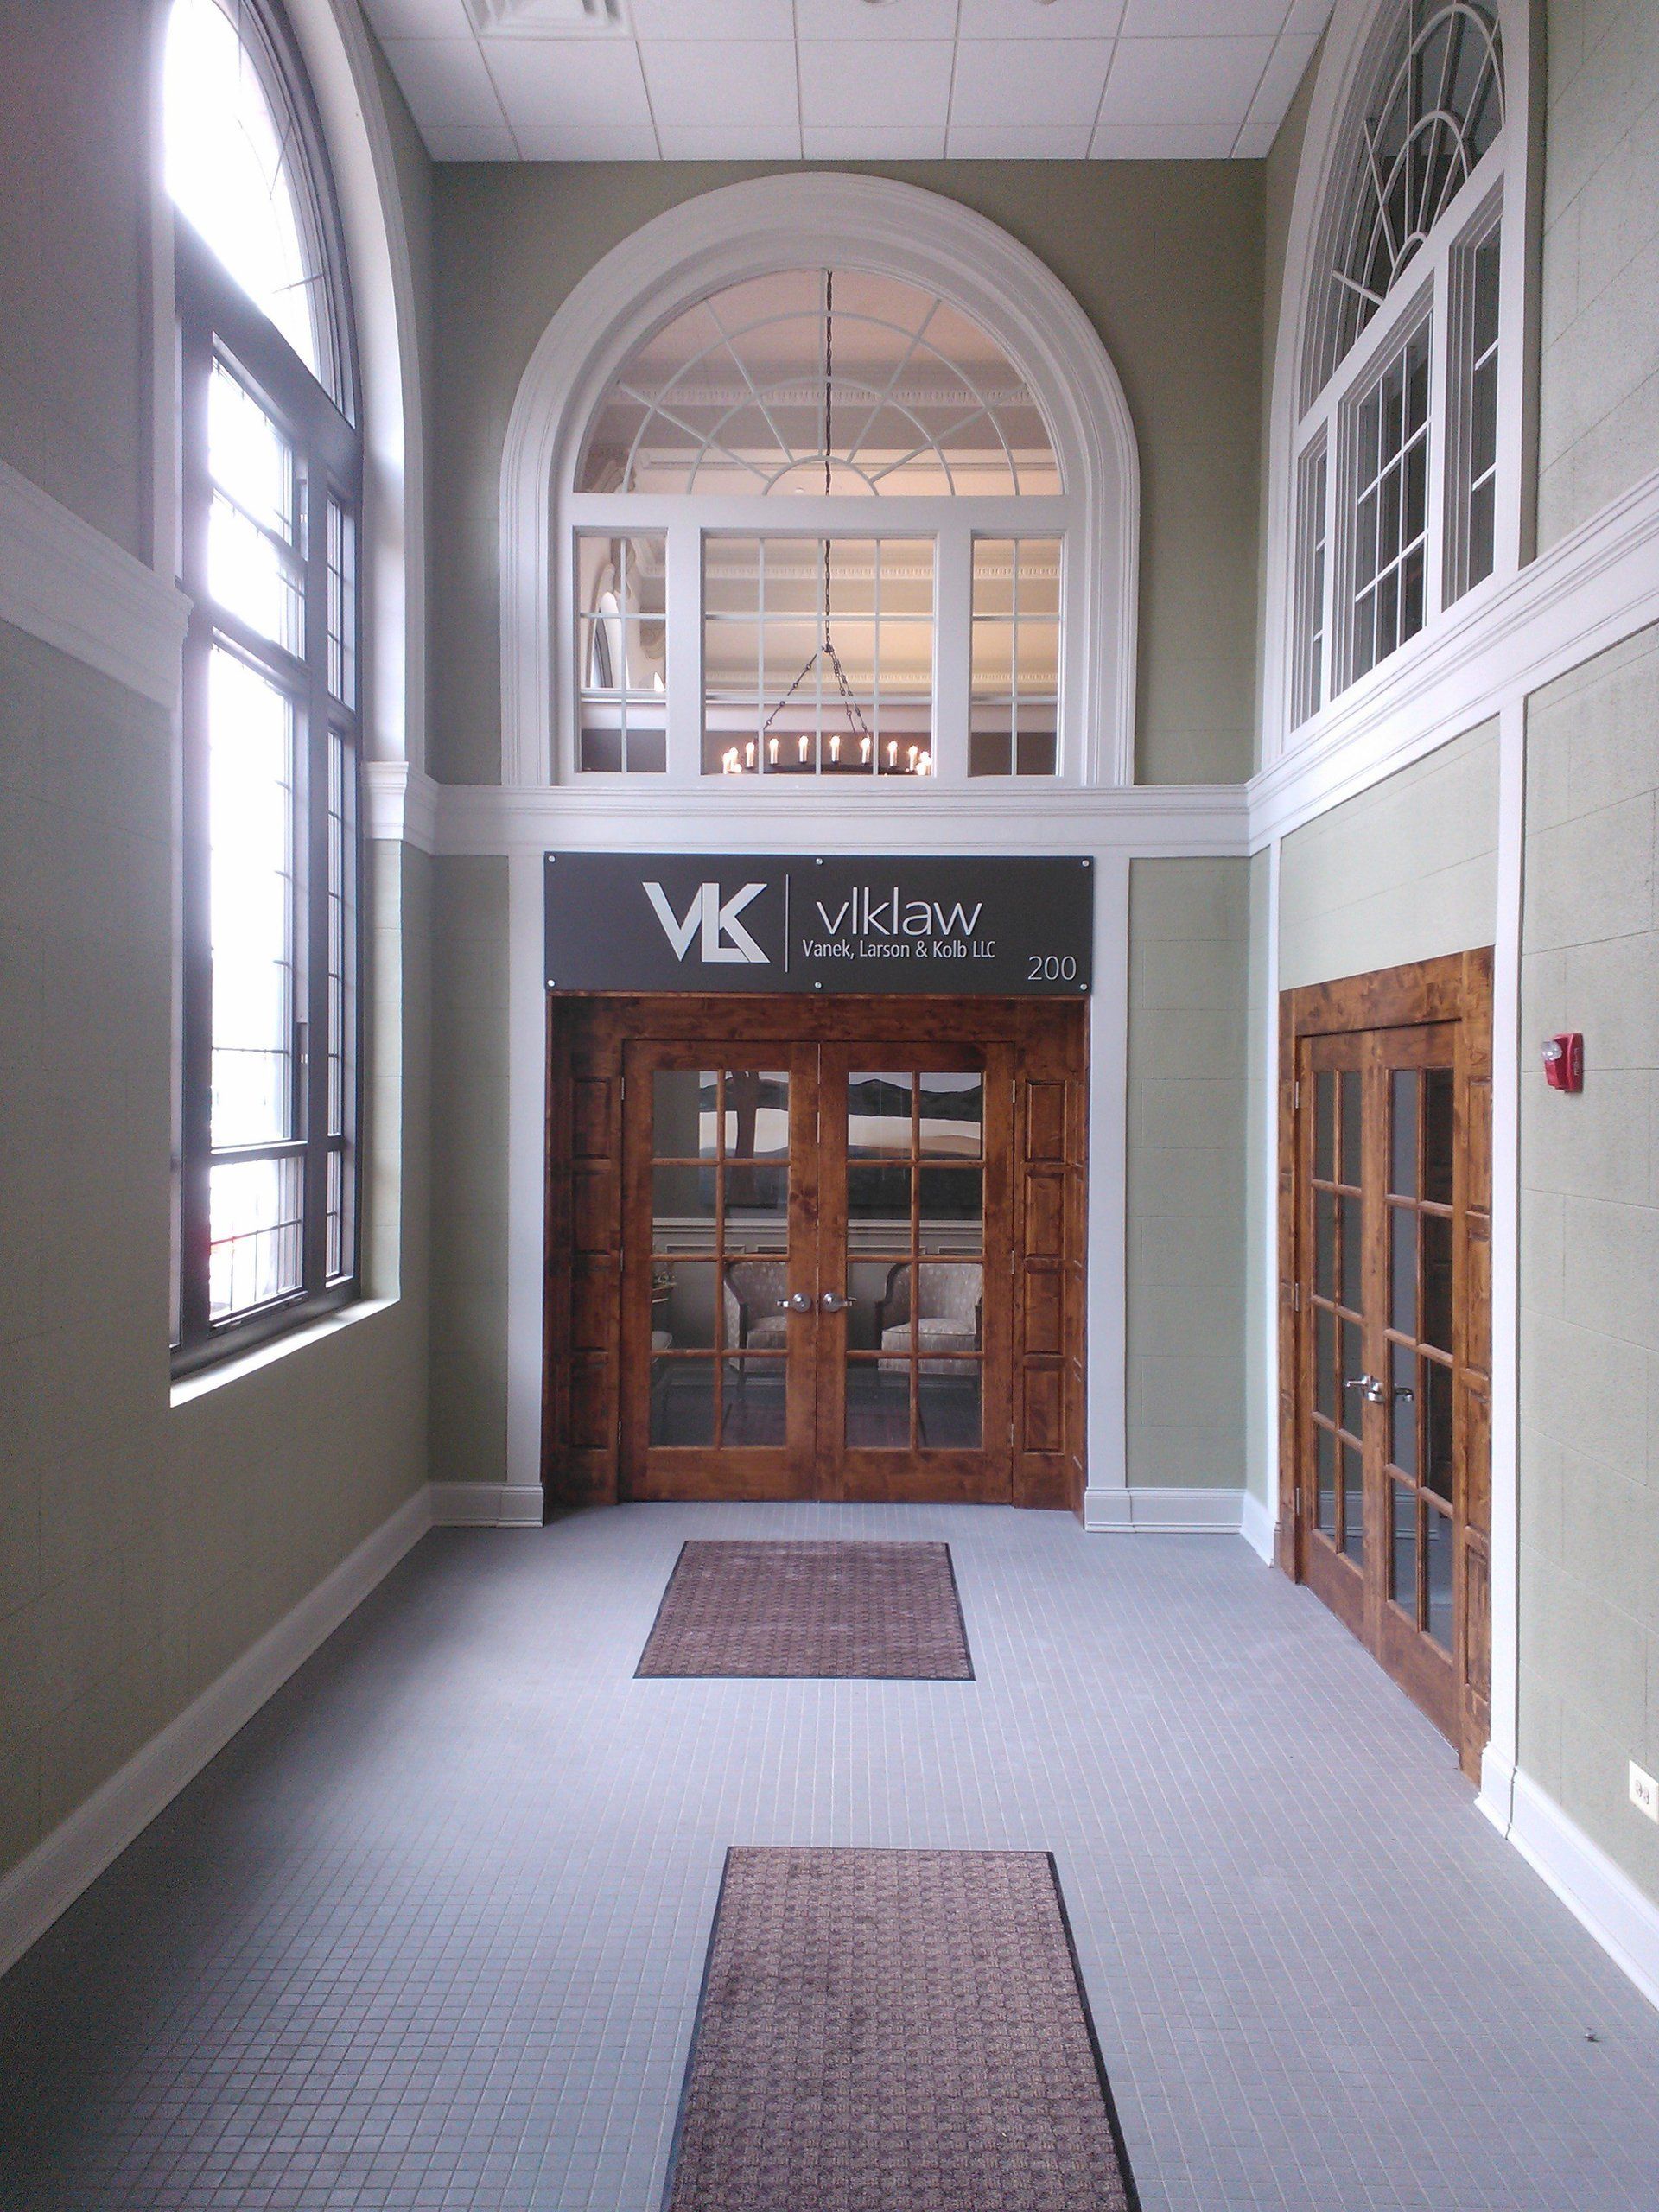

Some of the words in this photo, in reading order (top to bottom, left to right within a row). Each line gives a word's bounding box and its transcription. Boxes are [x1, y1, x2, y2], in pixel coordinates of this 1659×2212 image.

[816, 887, 982, 935] vlklaw
[803, 940, 856, 960] Vanek,
[859, 941, 911, 958] Larson
[916, 941, 929, 959] &
[933, 940, 969, 959] Kolb
[973, 941, 995, 959] LLC
[1027, 956, 1077, 981] 200
